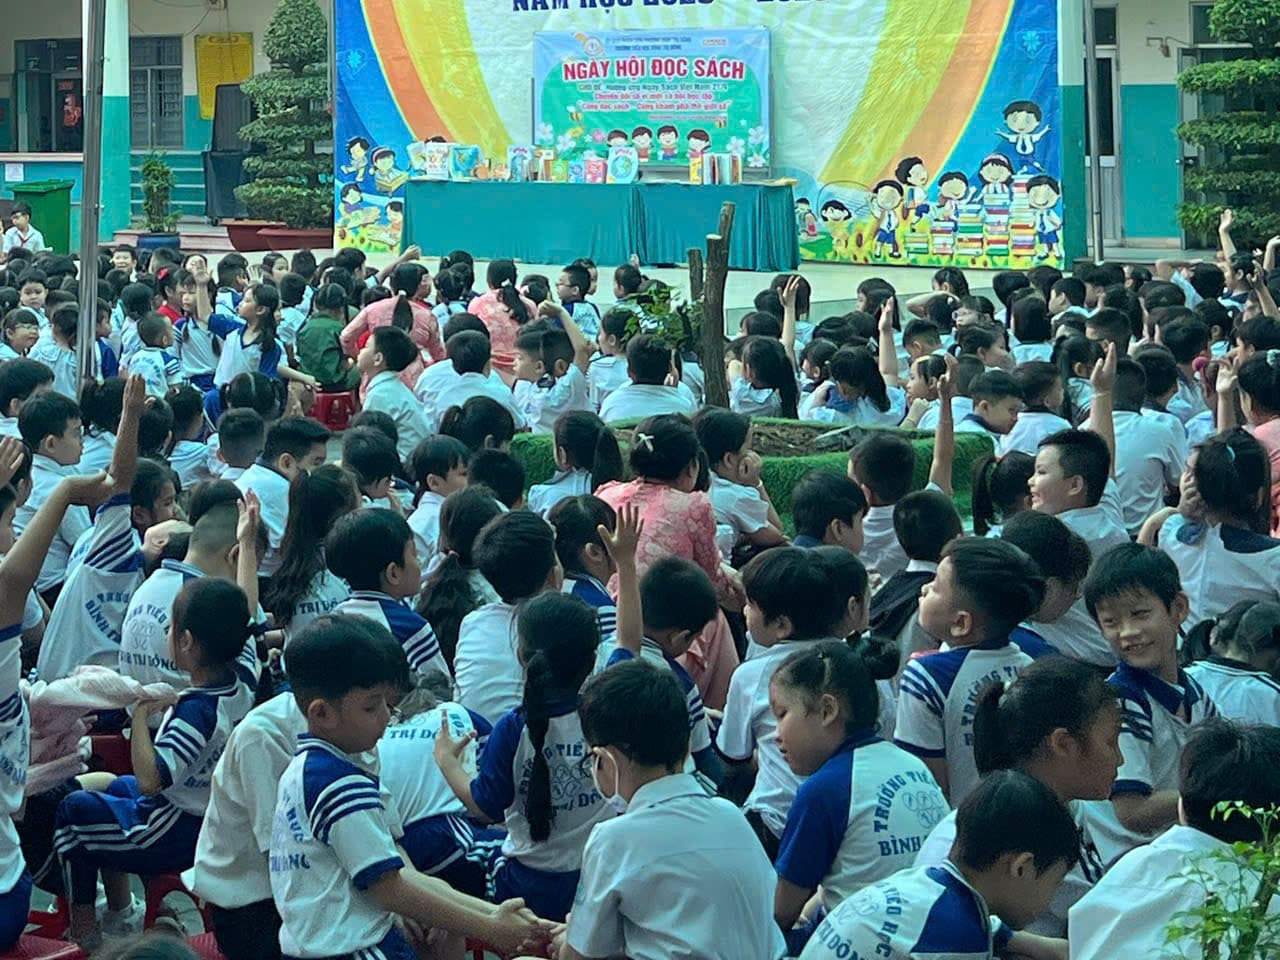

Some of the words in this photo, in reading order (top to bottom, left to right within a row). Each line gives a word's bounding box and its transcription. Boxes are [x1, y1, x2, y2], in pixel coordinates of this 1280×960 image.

[563, 57, 610, 80] NGÀY
[616, 56, 645, 80] HỘI
[651, 59, 688, 80] ĐỌC
[694, 56, 744, 79] SÁCH
[874, 775, 907, 833] TRƯỜNG
